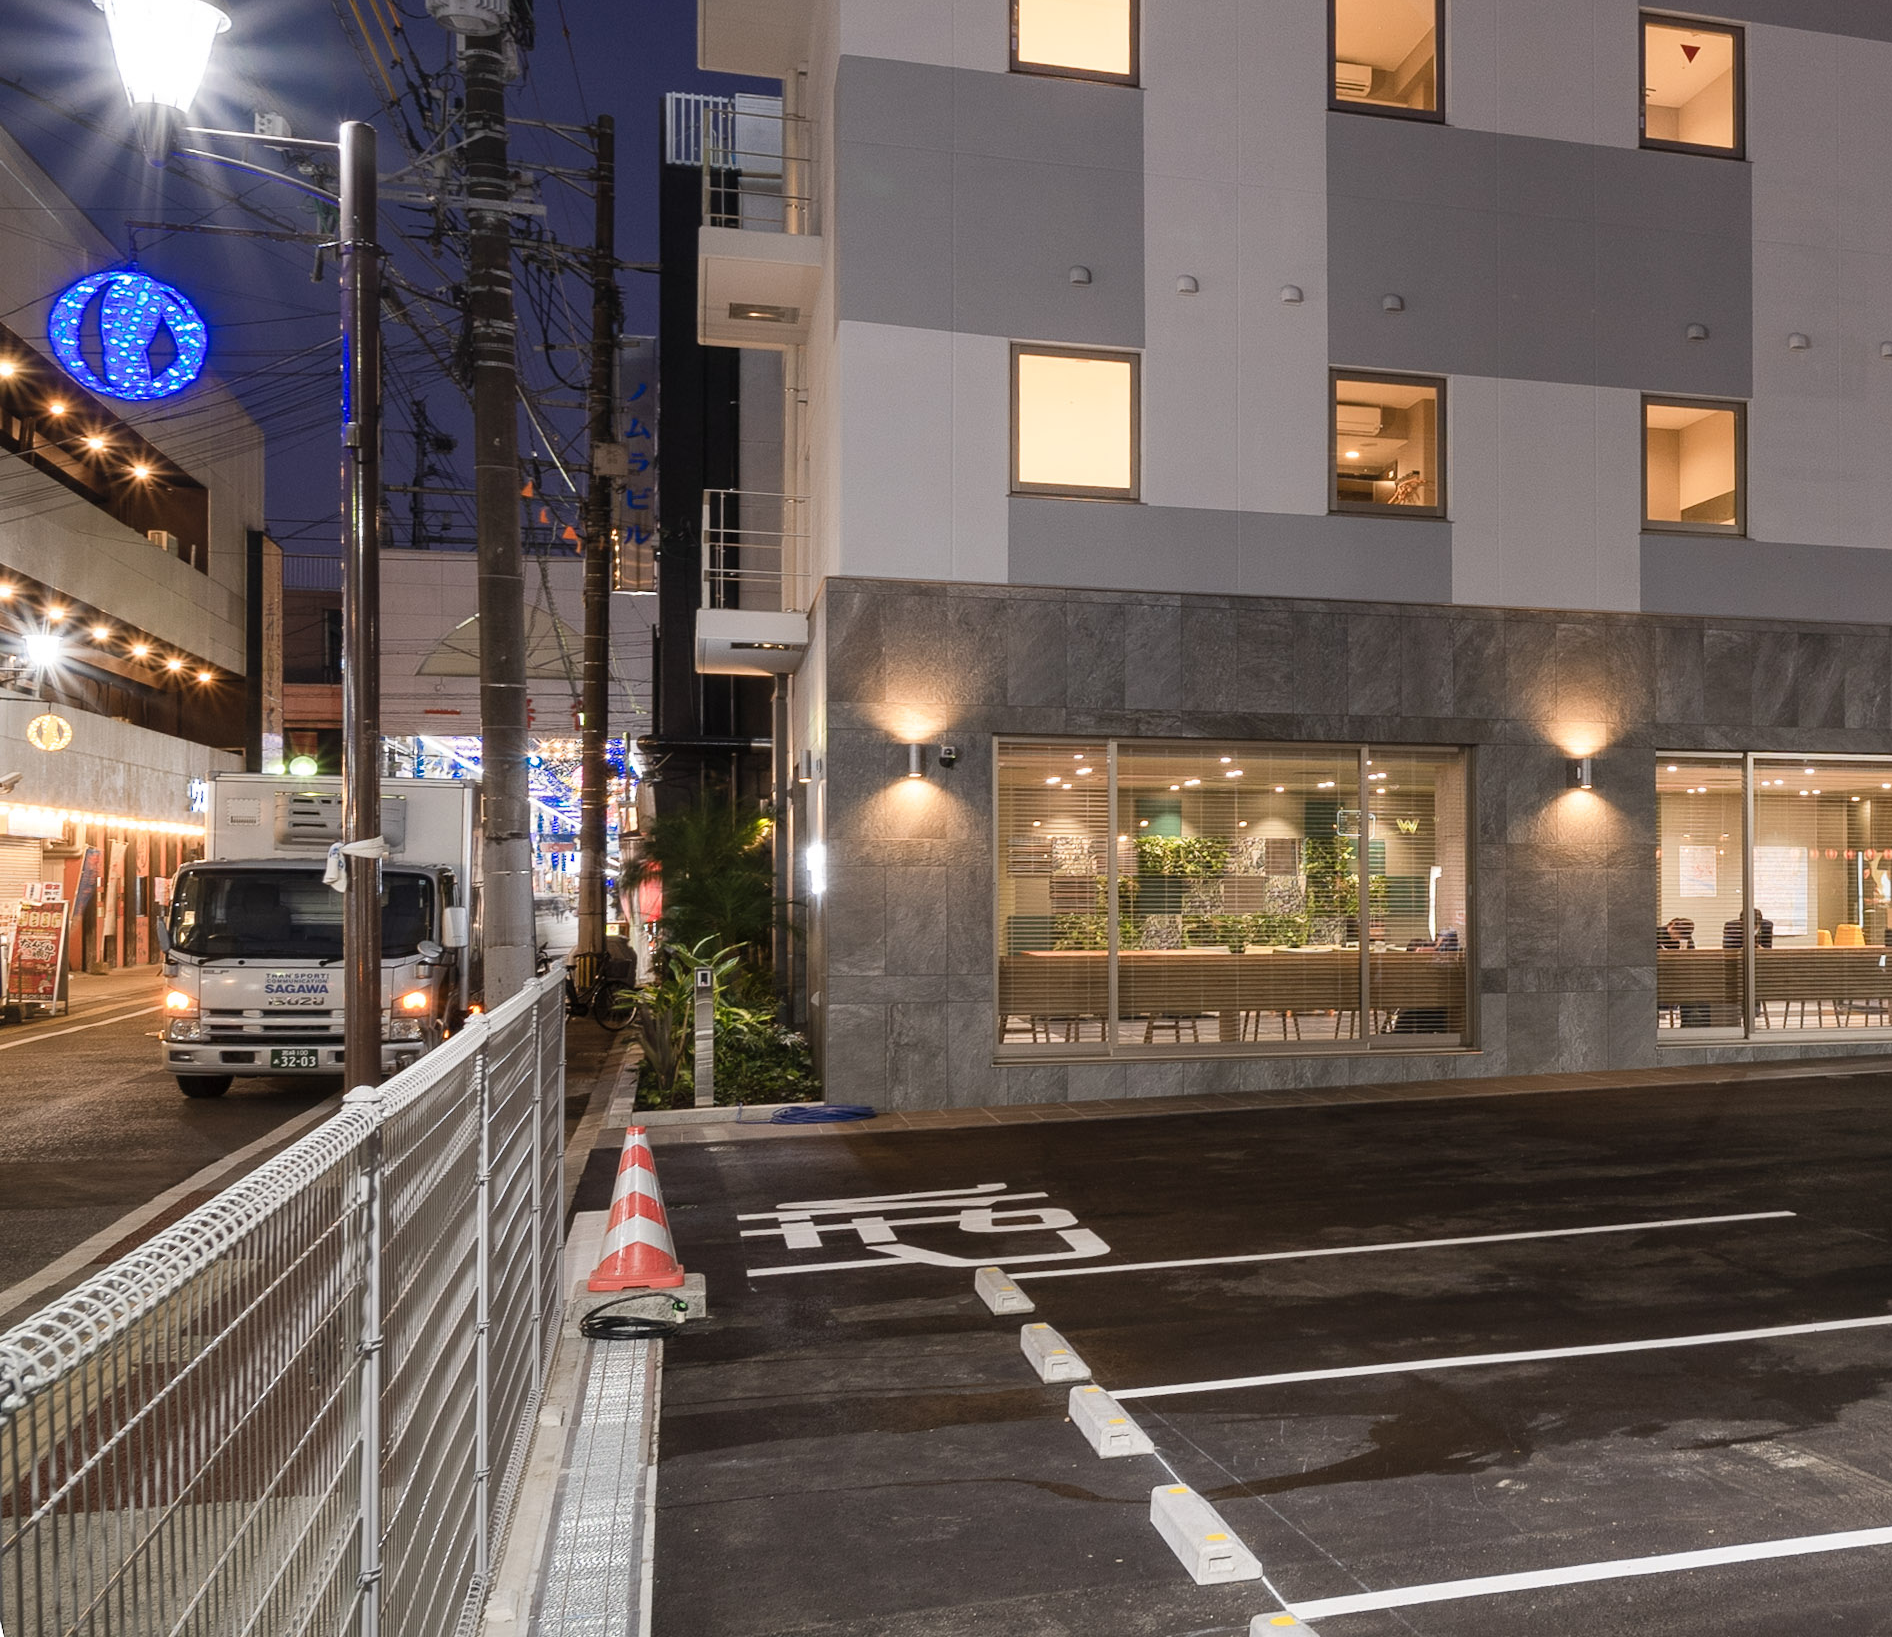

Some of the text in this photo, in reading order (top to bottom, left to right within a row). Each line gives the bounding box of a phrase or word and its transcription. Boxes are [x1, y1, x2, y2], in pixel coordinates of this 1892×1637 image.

[624, 382, 652, 546] ノムラビル
[265, 984, 329, 994] SAGAWA
[268, 996, 325, 1006] ISUZU
[280, 1056, 317, 1067] 32-03
